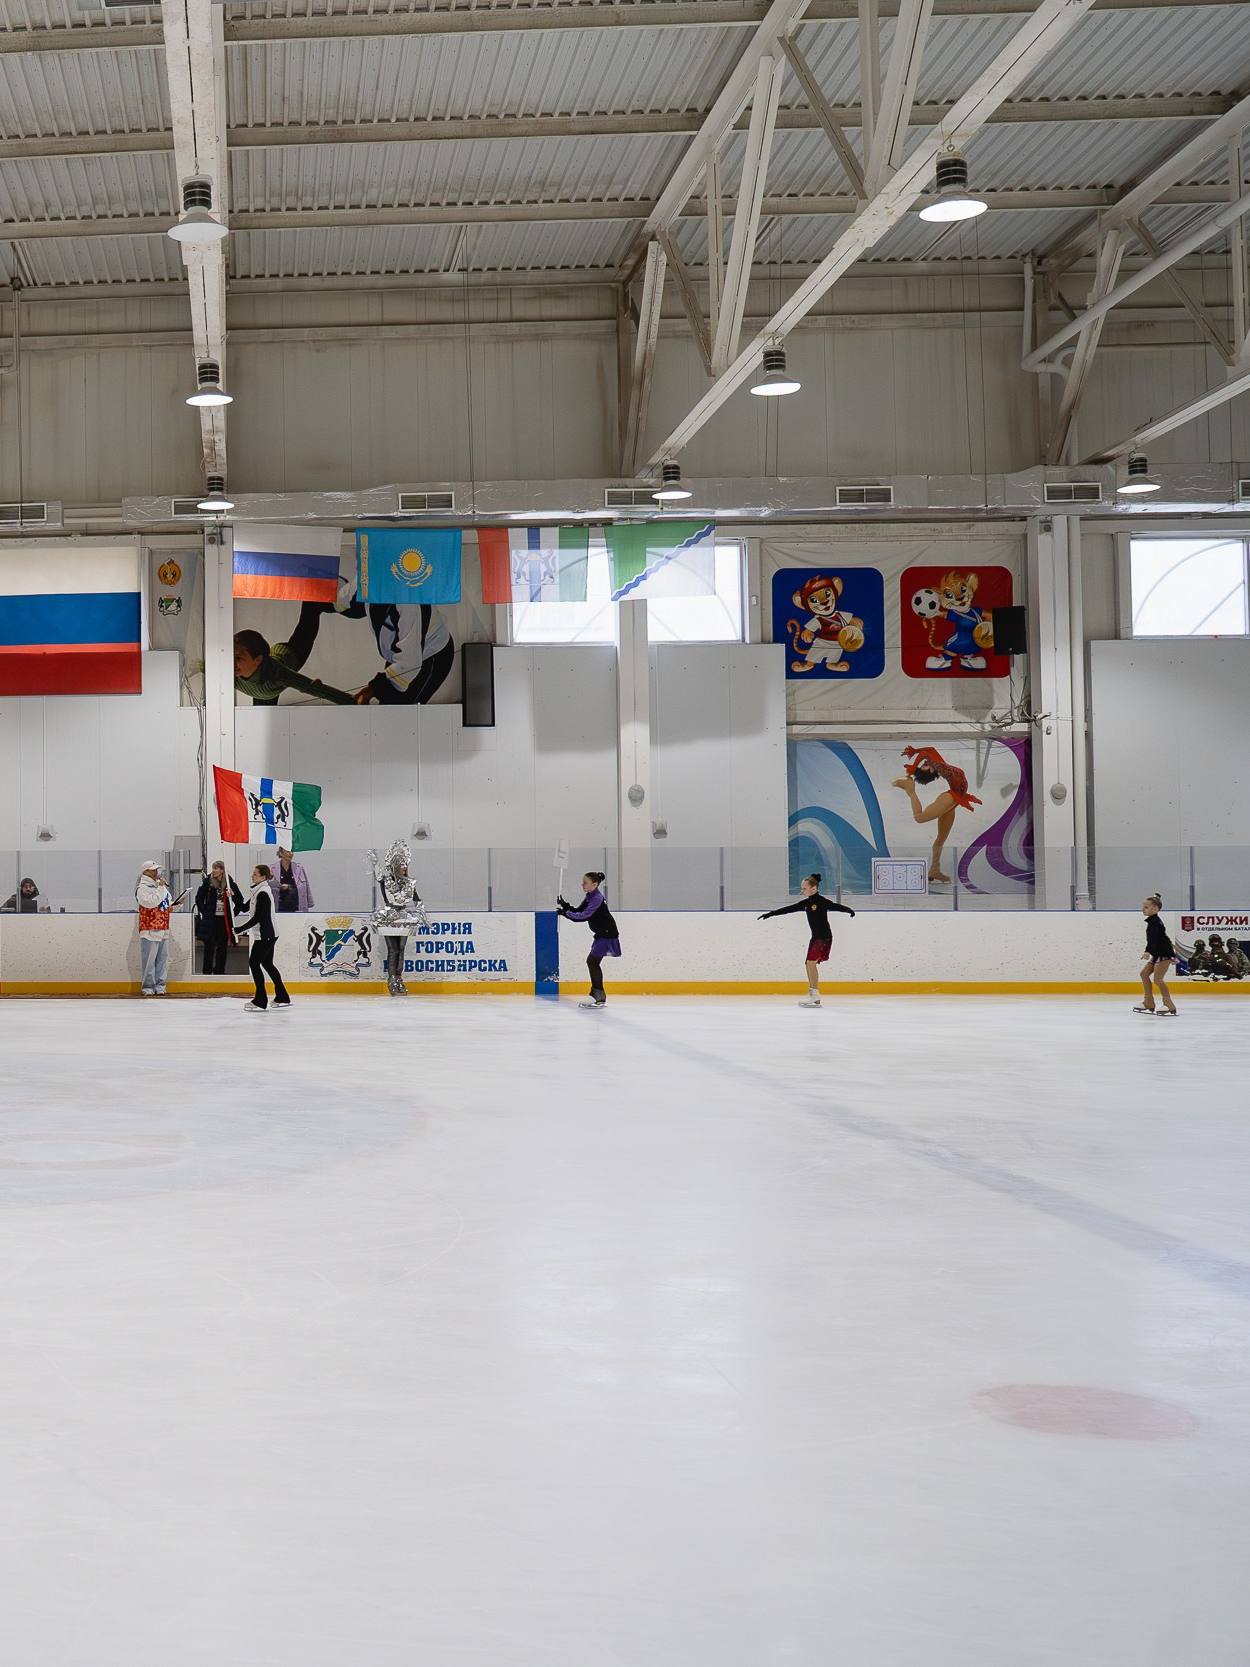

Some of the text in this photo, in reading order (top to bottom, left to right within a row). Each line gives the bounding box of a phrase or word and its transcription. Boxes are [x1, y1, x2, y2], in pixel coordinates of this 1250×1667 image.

[1196, 916, 1248, 925] СЛУЖИ
[417, 922, 473, 935] МЭРИЯ
[415, 940, 475, 955] ГОРОДА
[383, 959, 508, 972] ВОСИБИРСКА
